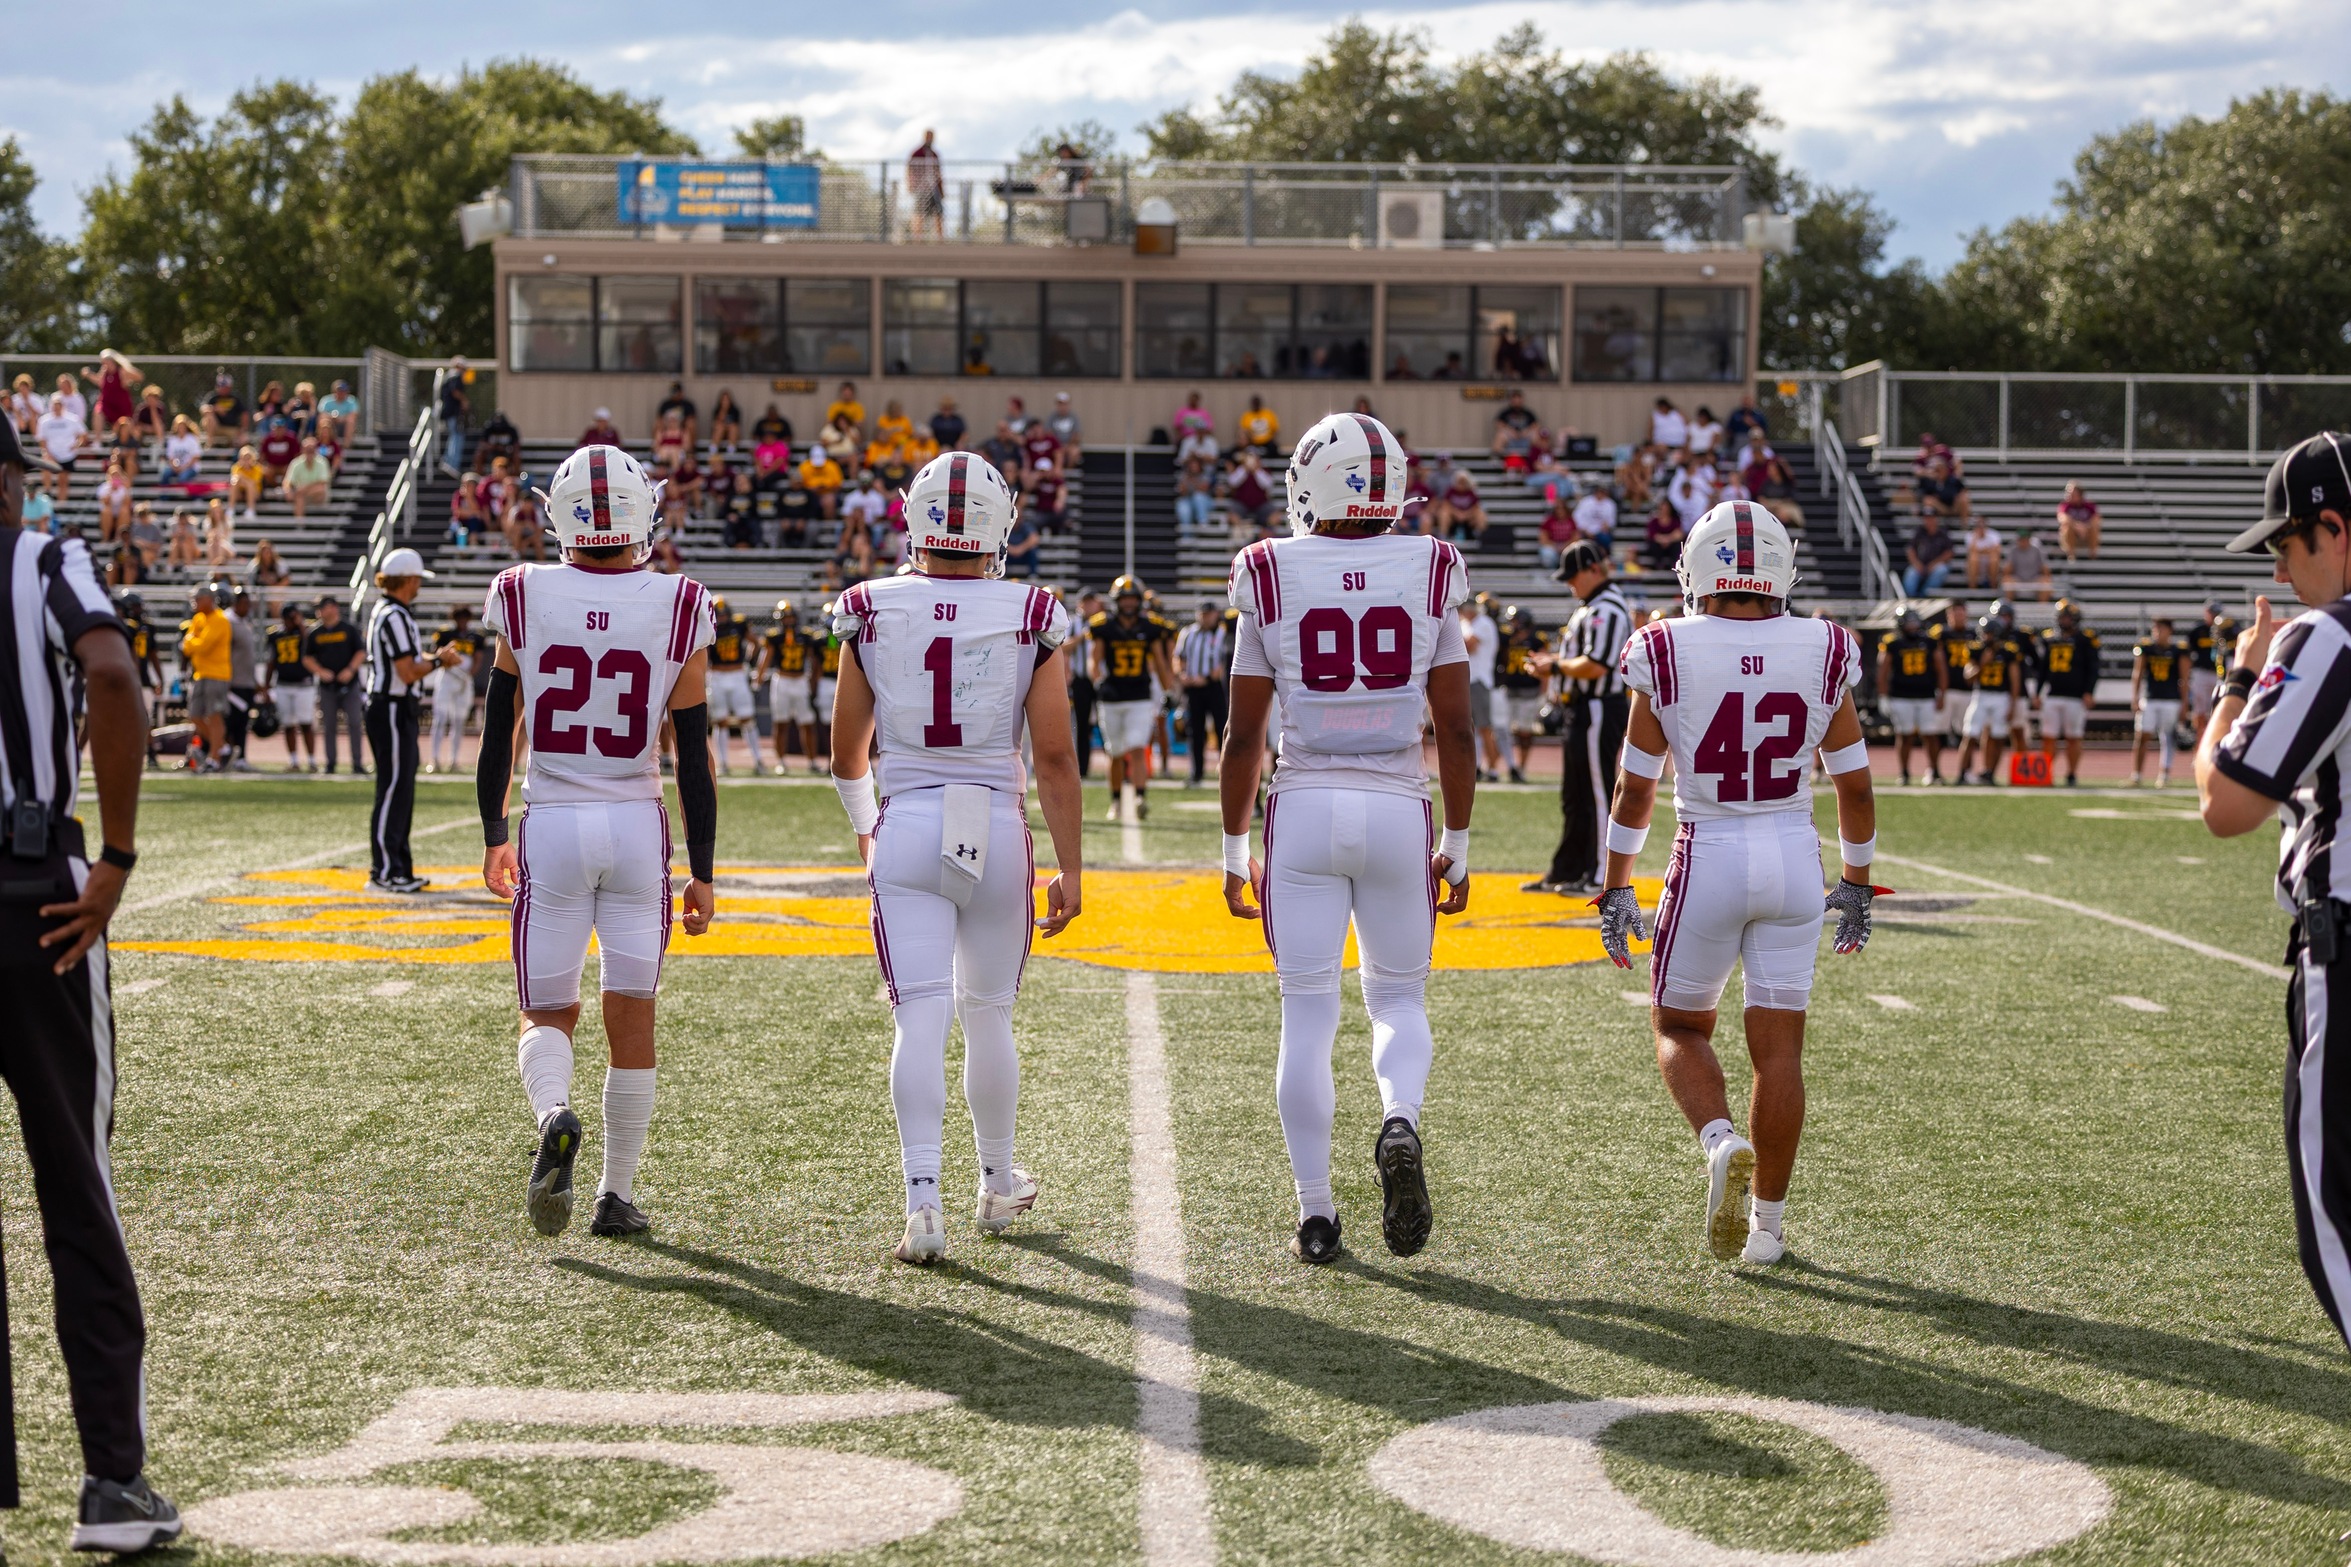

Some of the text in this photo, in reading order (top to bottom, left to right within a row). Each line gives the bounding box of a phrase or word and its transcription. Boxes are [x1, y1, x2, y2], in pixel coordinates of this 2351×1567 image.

[2311, 486, 2324, 503] S
[1346, 505, 1398, 517] Riddell
[575, 533, 631, 545] Riddell
[925, 535, 980, 551] Riddell
[1342, 571, 1366, 591] SU
[1716, 578, 1772, 593] Riddell
[586, 611, 610, 631] SU
[933, 603, 957, 622] SU
[1298, 606, 1413, 692] 89
[1113, 647, 1145, 678] 53
[1741, 656, 1764, 675] SU
[533, 644, 652, 759] 23
[924, 637, 963, 748] 1
[1694, 692, 1808, 802] 42
[2016, 752, 2047, 779] 40
